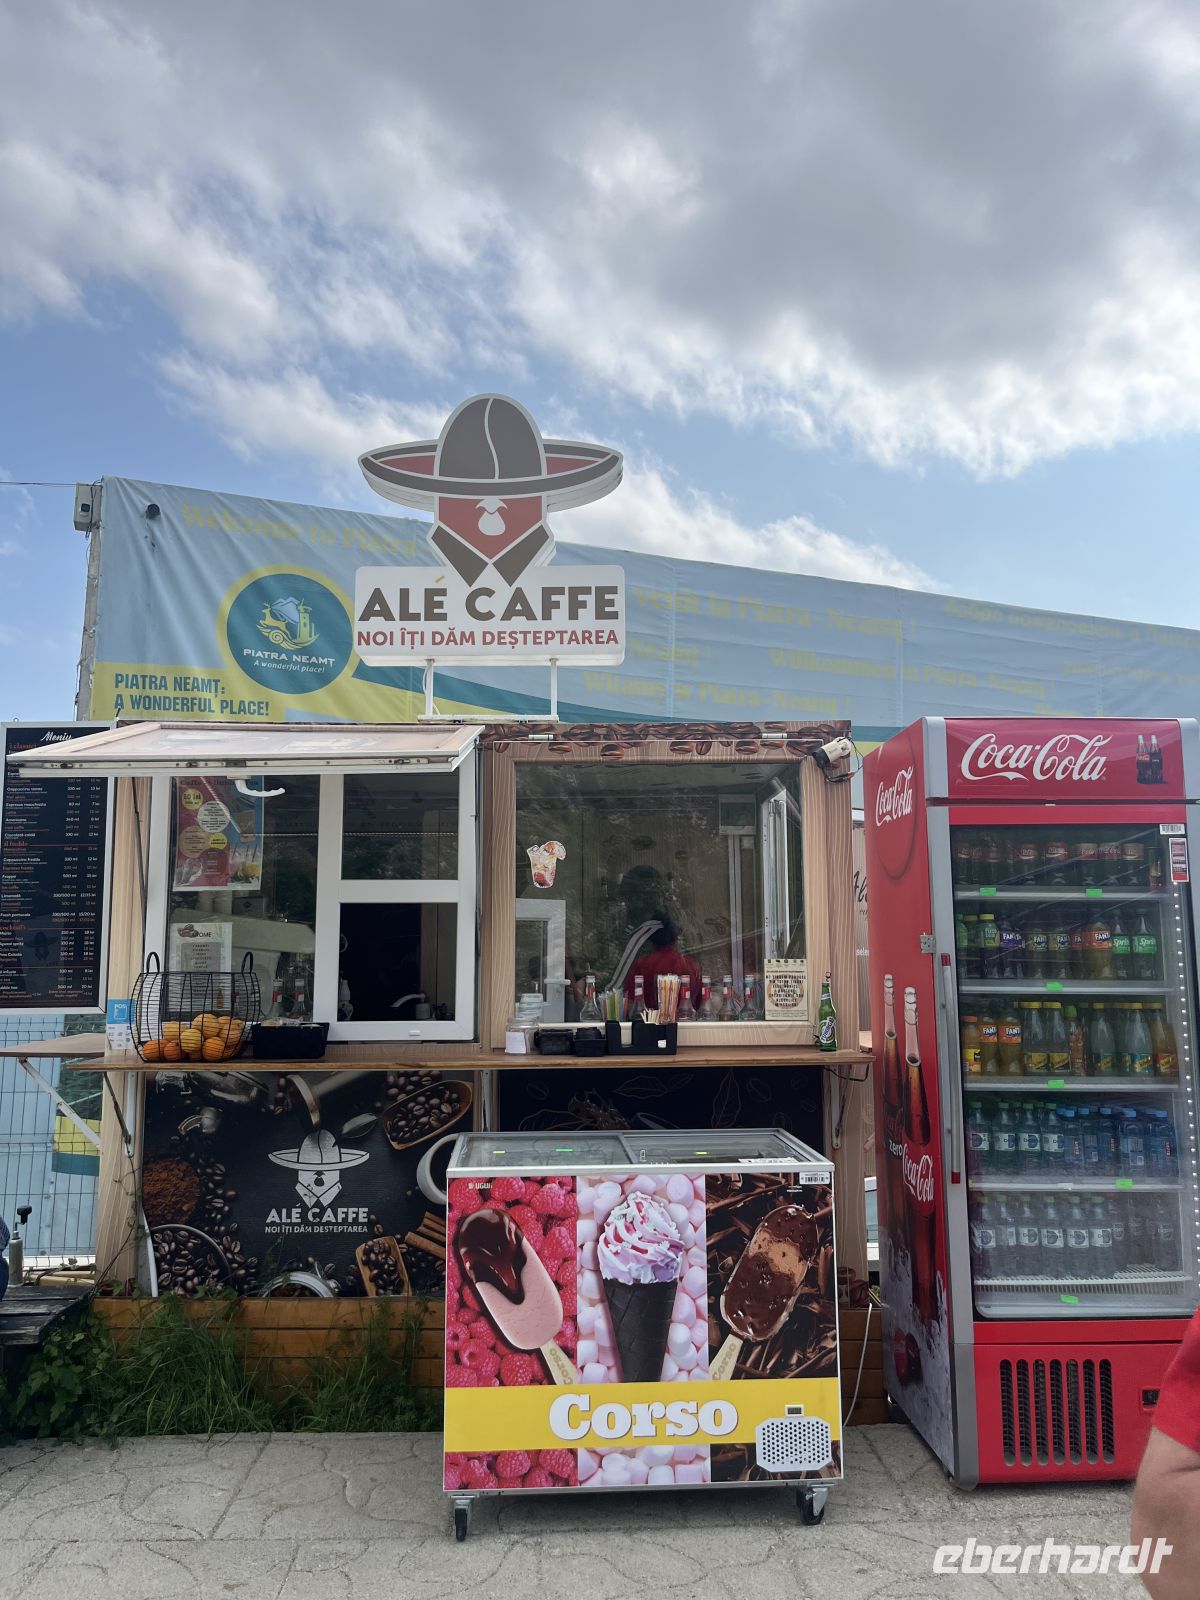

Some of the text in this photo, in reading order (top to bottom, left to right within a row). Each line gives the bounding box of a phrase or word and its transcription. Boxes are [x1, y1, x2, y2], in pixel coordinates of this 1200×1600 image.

[358, 575, 619, 622] ALÉ CAFFE
[357, 627, 619, 649] NOI ÎȚI DĂM DEȘTEPTAREA
[243, 648, 288, 662] PIATRA
[253, 659, 326, 673] A wonderful place!
[114, 673, 168, 691] PIATRA
[114, 693, 270, 716] A WONDERFUL PLACE!
[961, 733, 1113, 781] Coca-Cola
[875, 765, 914, 828] Coca-Cola
[889, 1139, 903, 1156] zero
[902, 1143, 934, 1202] Coca-Cola
[266, 1203, 369, 1223] ALÉ CAFFE
[294, 1225, 312, 1233] DĂM
[549, 1393, 738, 1440] Corso
